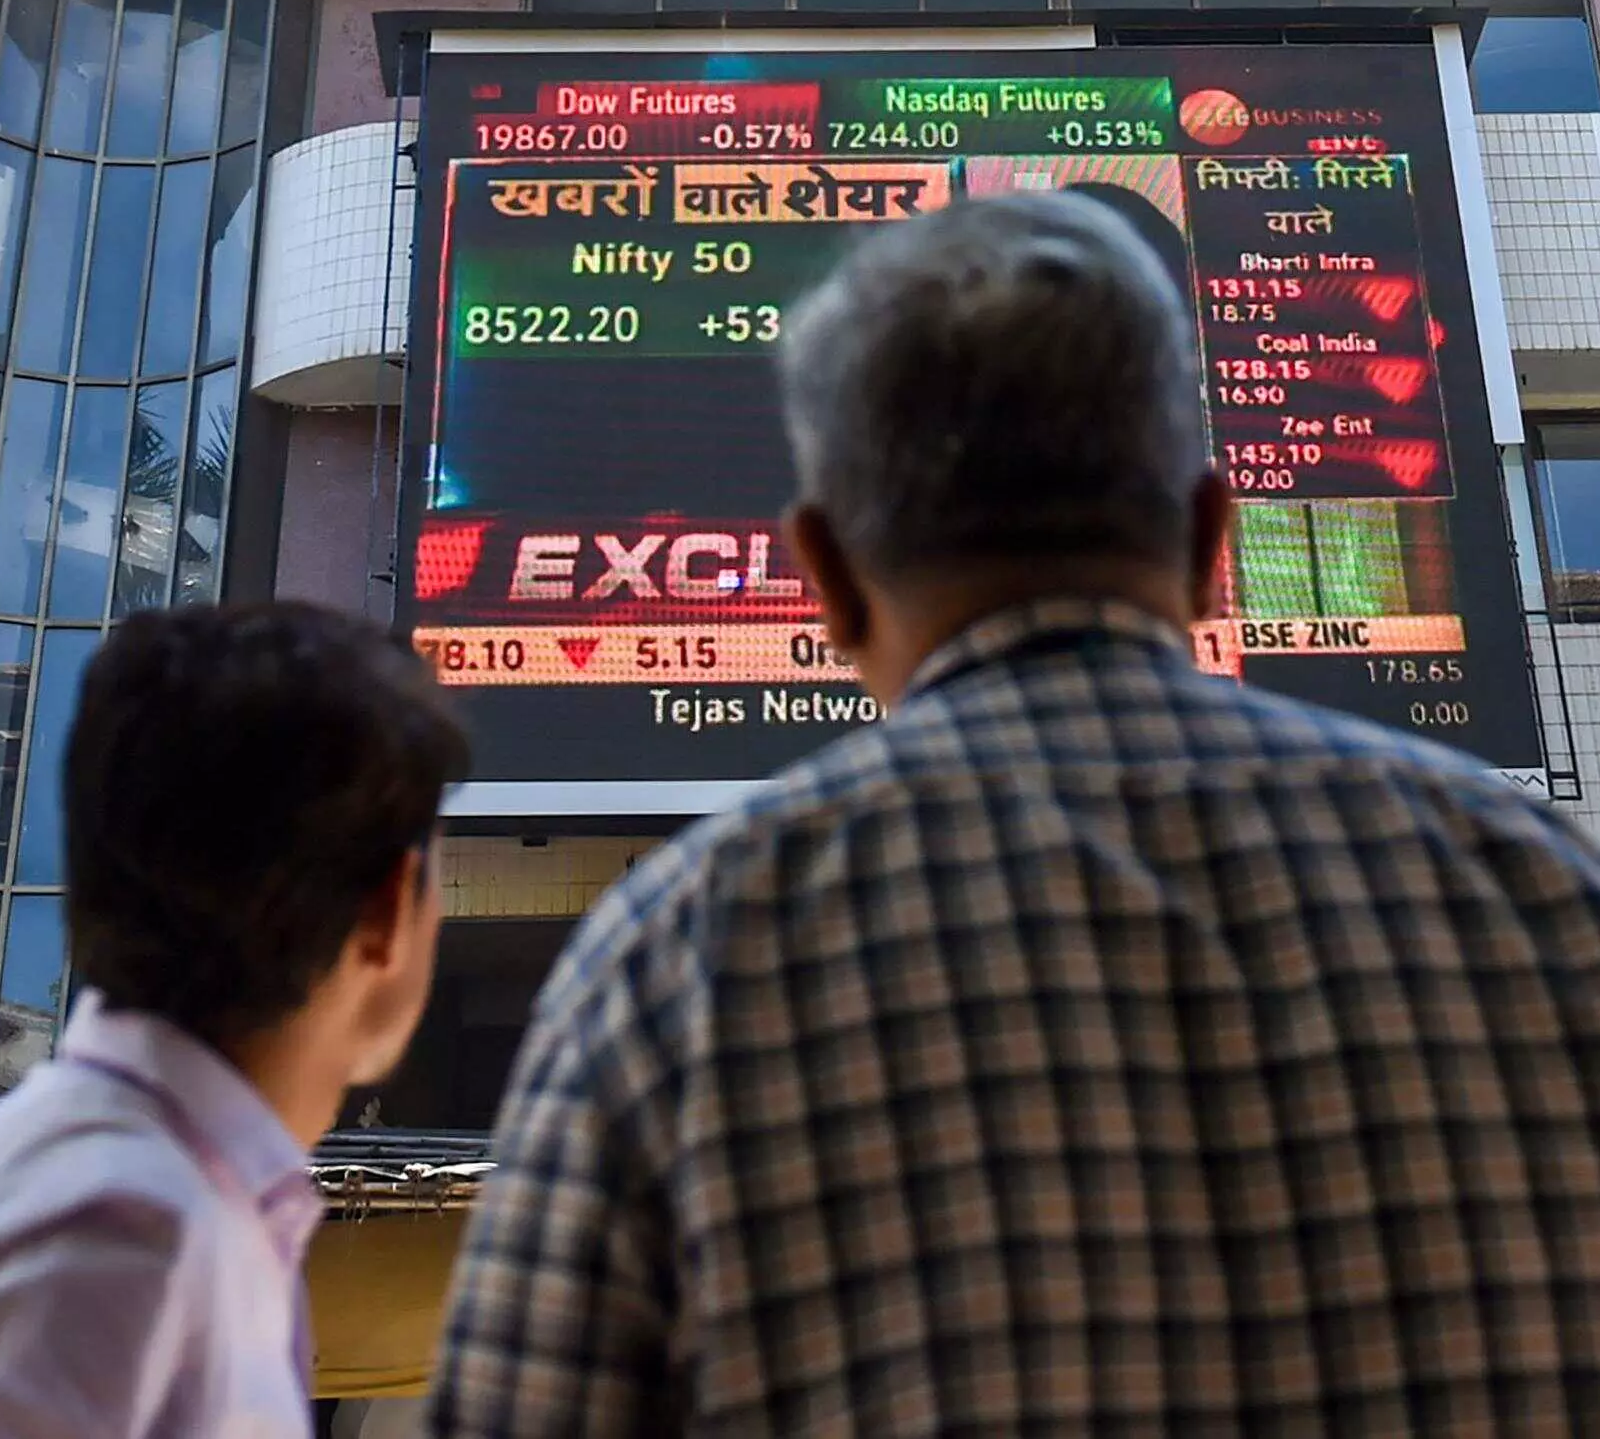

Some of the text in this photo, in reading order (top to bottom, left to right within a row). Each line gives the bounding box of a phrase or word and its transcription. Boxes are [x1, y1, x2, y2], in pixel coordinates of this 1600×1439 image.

[556, 86, 738, 115] Dow Futures
[885, 85, 1106, 119] Nasdaq Futures
[476, 123, 813, 151] 19867.00 -0.57%
[827, 120, 1164, 149] 7244.00 +0.53%
[1312, 156, 1395, 191] गिरने
[487, 164, 928, 220] खबरों वाले शेयर
[1264, 204, 1334, 236] वाले
[572, 241, 752, 282] Nifty 50
[1239, 252, 1376, 272] Bharti Infra
[1207, 278, 1302, 299] 131.15
[465, 305, 781, 344] 8522.20 +53
[1211, 303, 1277, 323] 18.75
[1256, 331, 1378, 354] Coal India
[1215, 359, 1312, 381] 128.15
[1217, 385, 1286, 406] 16.90
[1280, 415, 1375, 437] Zee Ent
[1224, 444, 1322, 465] 145.10
[1228, 468, 1295, 491] 19.00
[508, 532, 803, 600] EXCL
[1241, 621, 1371, 649] BSE ZINC
[635, 636, 718, 669] 5.15
[1366, 659, 1464, 684] 178.65
[649, 688, 889, 733] Tejas Netwo
[1409, 700, 1470, 726] 0.00
